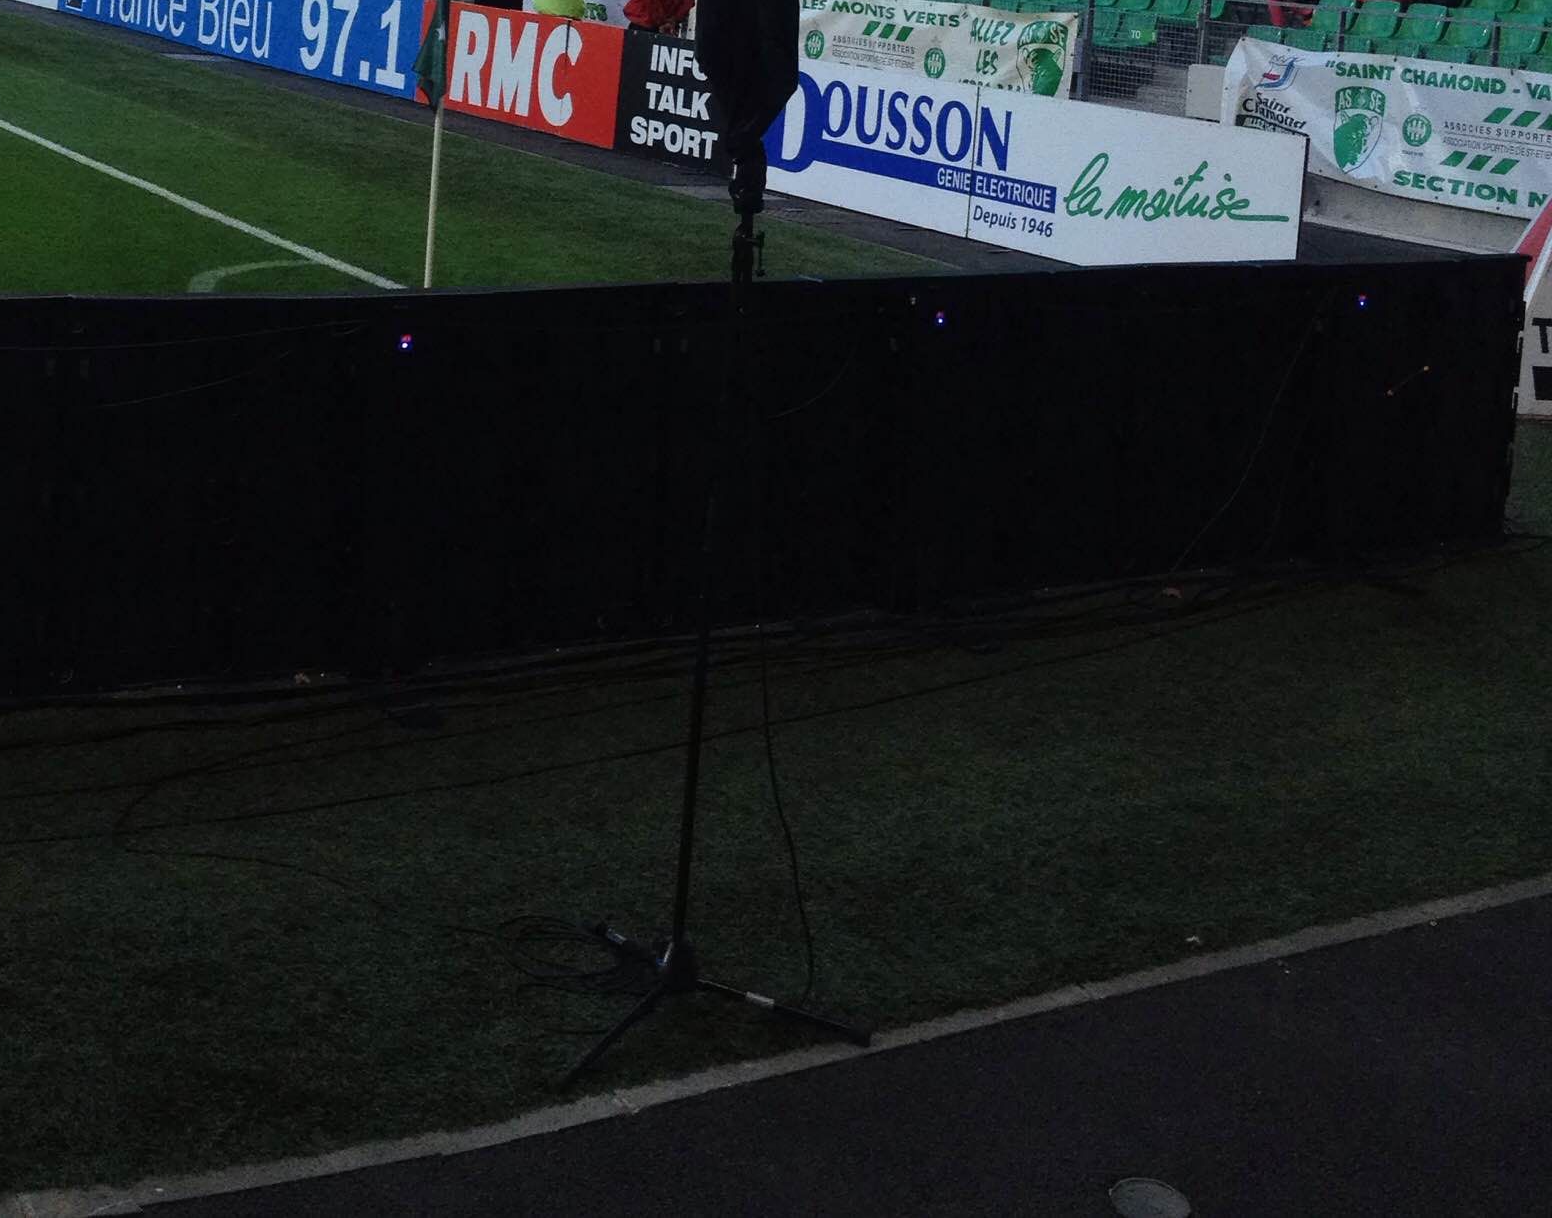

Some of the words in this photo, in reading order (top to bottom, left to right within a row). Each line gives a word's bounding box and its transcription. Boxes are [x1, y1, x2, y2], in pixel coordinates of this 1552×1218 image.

[832, 0, 896, 21] MONTS
[969, 16, 1016, 47] ALLEZ
[449, 10, 583, 127] RMC
[1399, 68, 1507, 95] CHAMOND
[645, 82, 712, 121] TALK
[1256, 92, 1291, 114] Saint
[630, 116, 719, 161] SPORT
[937, 167, 971, 192] GENIE
[975, 174, 1053, 210] ELECTRIQUE
[1064, 152, 1102, 217] la
[1394, 170, 1518, 205] SECTION
[972, 204, 1017, 233] Depuis
[1021, 215, 1054, 239] 1946
